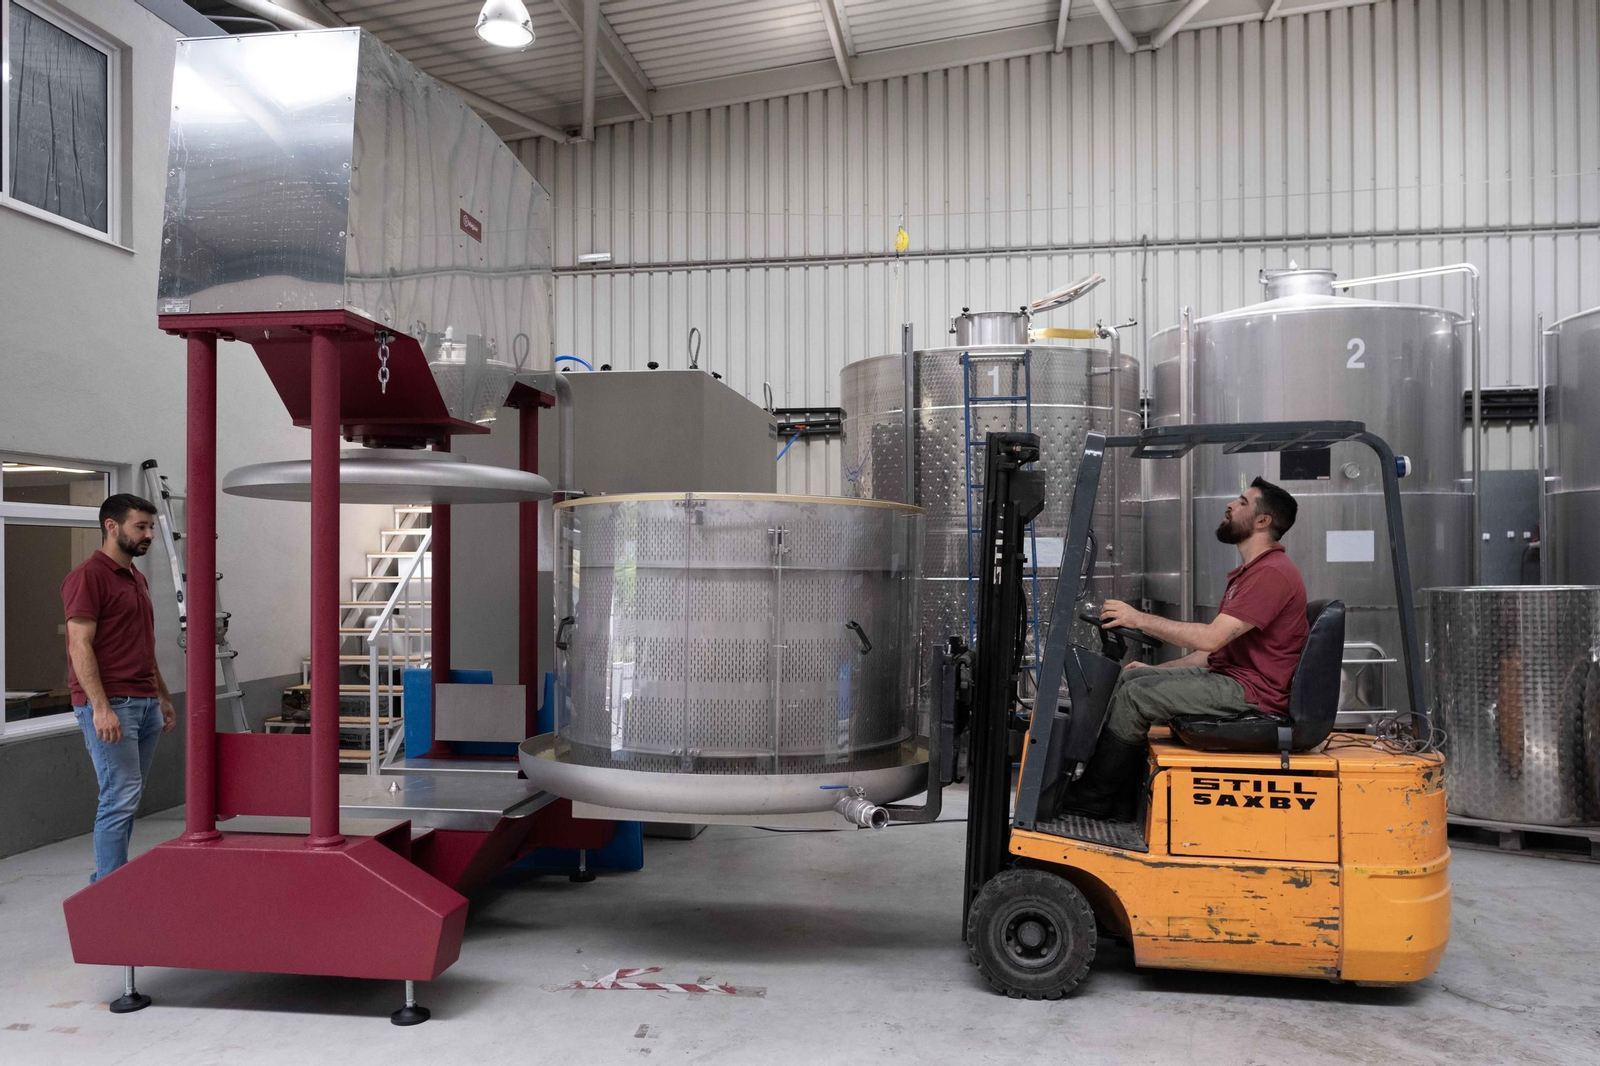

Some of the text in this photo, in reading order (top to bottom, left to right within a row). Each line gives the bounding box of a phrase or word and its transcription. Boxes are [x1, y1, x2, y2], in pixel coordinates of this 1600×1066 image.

[1346, 337, 1366, 369] 2
[987, 365, 1000, 396] 1
[1193, 777, 1317, 795] STILL
[1193, 793, 1316, 810] SAXBY
